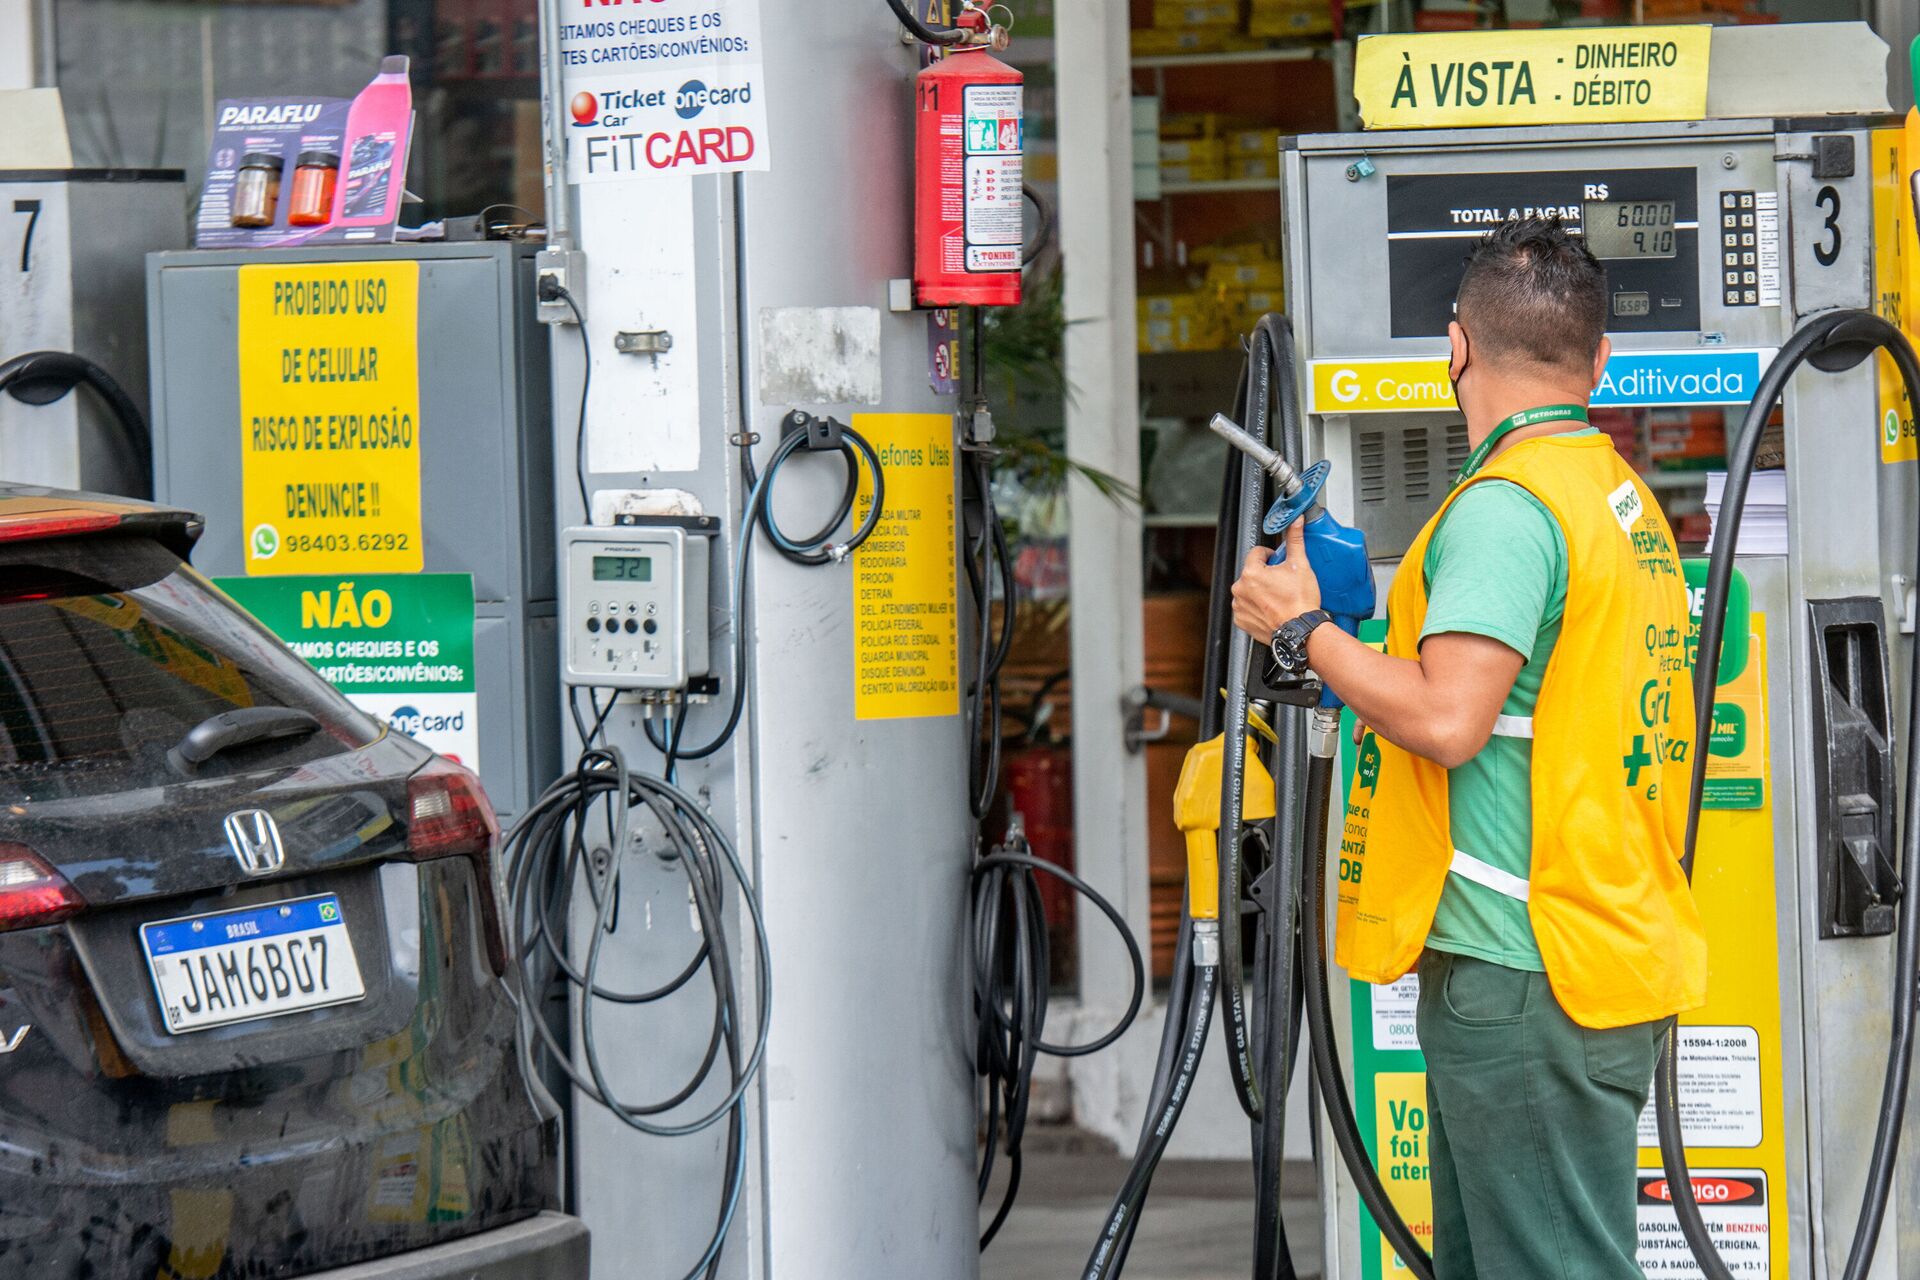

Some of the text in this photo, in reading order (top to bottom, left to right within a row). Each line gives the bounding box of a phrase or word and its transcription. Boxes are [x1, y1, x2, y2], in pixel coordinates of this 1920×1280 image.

[619, 17, 685, 36] CHEQUES
[690, 15, 698, 30] E
[702, 12, 721, 28] OS
[1576, 41, 1677, 69] DINHEIRO
[1391, 52, 1536, 108] À VISTA
[1573, 75, 1651, 106] DÉBITO
[600, 89, 666, 110] Ticket
[219, 104, 322, 125] PARAFLU
[603, 115, 628, 127] Car
[1584, 183, 1609, 201] R$
[1450, 207, 1503, 223] TOTAL
[1524, 205, 1581, 220] PAGAR
[1618, 204, 1672, 228] 60.00
[1728, 217, 1733, 225] 3
[14, 200, 41, 273] 7
[1813, 185, 1841, 267] 3
[1634, 231, 1672, 253] 9.10
[1729, 236, 1734, 244] 5
[1730, 274, 1735, 282] 9
[274, 278, 386, 315] PROIBIDO USO
[282, 347, 378, 383] DE CELULAR
[1376, 378, 1452, 400] Comu
[1599, 368, 1743, 397] Aditivada
[1529, 410, 1572, 419] PETROBRAS
[253, 416, 298, 451] RISCO
[304, 415, 322, 450] DE
[1466, 443, 1489, 475] PETROBRAS
[286, 482, 366, 518] DENUNCIE
[896, 510, 921, 520] MILITAR
[893, 525, 910, 536] CIVIL
[286, 533, 408, 552] 98403.6292
[860, 541, 905, 552] BOMBEIROS
[861, 573, 894, 583] PROCON
[301, 582, 393, 628] NÃO
[861, 589, 892, 600] DETRAN
[881, 603, 927, 614] ATENDIMENTO
[893, 619, 924, 630] FEDERAL
[336, 641, 403, 659] CHEQUES
[405, 641, 415, 657] E
[418, 641, 439, 657] OS
[861, 650, 929, 663] GUARDA MUNICIPAL
[316, 662, 463, 683] ARTÕES/CONVÊNIOS:
[861, 667, 891, 679] DISQUE
[861, 683, 893, 695] CENTRO
[1235, 735, 1244, 768] DIMEL
[1232, 779, 1241, 830] INMETRO
[225, 920, 260, 939] BRASIL
[180, 934, 329, 1014] JAM6B07
[1233, 984, 1242, 1023] STATIO
[1172, 1074, 1188, 1102] SUPER
[1184, 1053, 1196, 1072] GAS
[1191, 1008, 1207, 1050] STATION
[1205, 967, 1214, 982] BC
[1236, 1027, 1245, 1048] GAS
[1389, 1024, 1415, 1035] 0800
[1683, 1039, 1747, 1048] 15594-1:2008
[1389, 1100, 1425, 1131] Vo
[1390, 1135, 1419, 1158] foi
[1661, 1184, 1729, 1200] PIGO
[1726, 1224, 1768, 1233] BENZENO
[1743, 1261, 1761, 1269] 13.1
